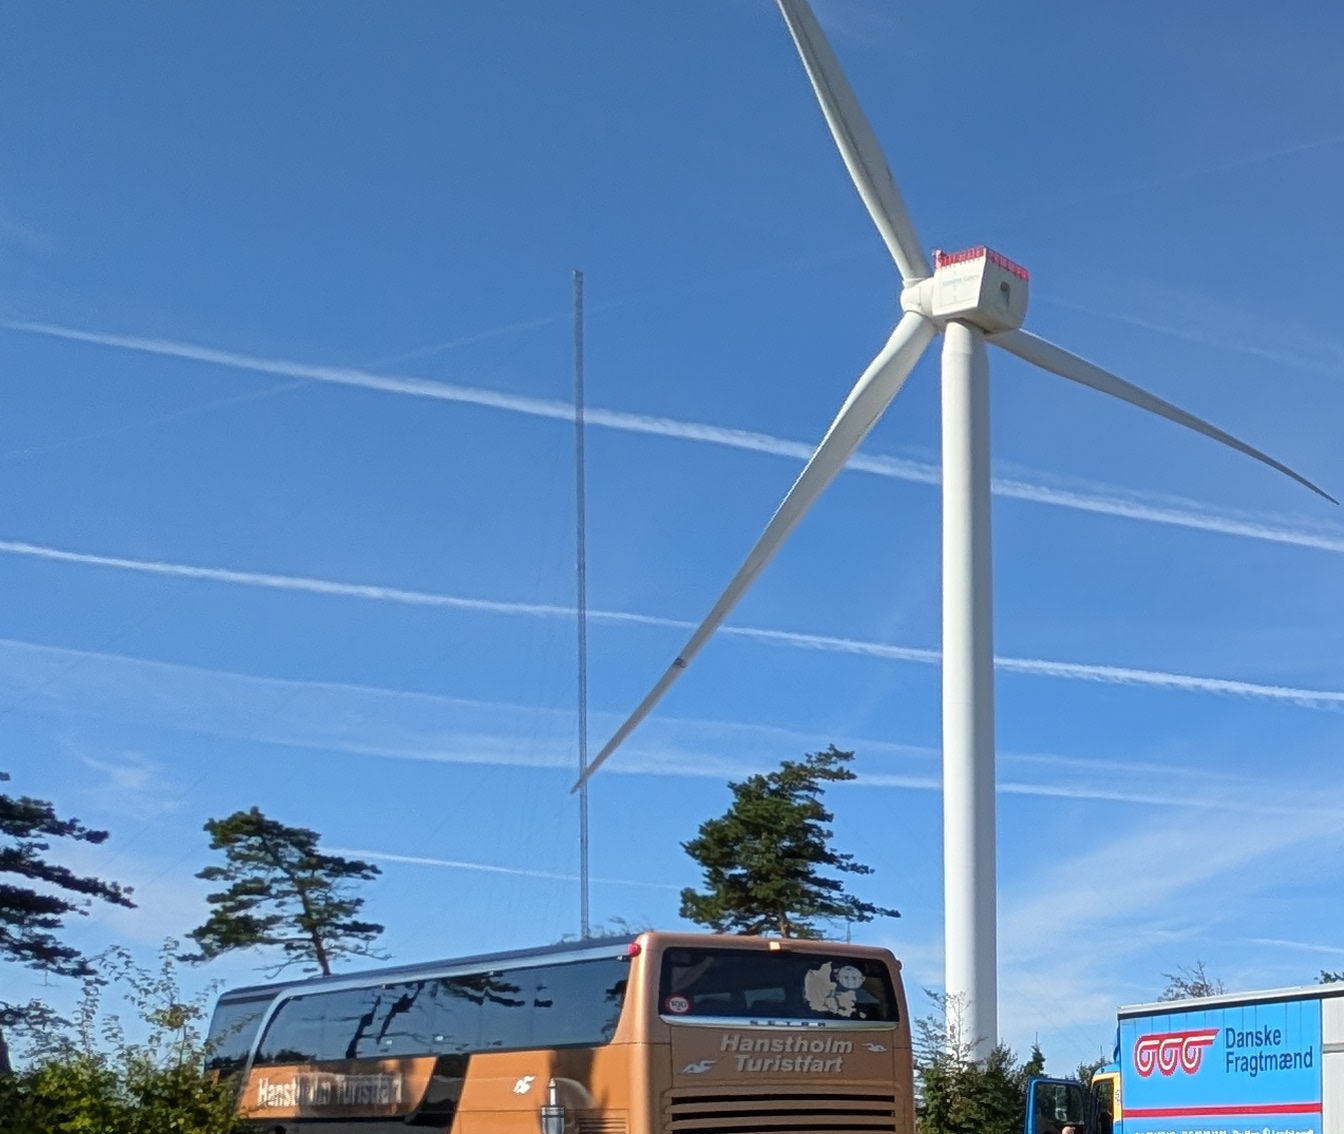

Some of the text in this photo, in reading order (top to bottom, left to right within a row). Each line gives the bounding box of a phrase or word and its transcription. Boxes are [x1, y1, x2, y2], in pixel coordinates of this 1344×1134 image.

[719, 1033, 854, 1054] Hanstholm
[1225, 1025, 1282, 1049] Danske
[734, 1053, 844, 1073] Turistfart
[1225, 1046, 1313, 1078] Fragtmænd
